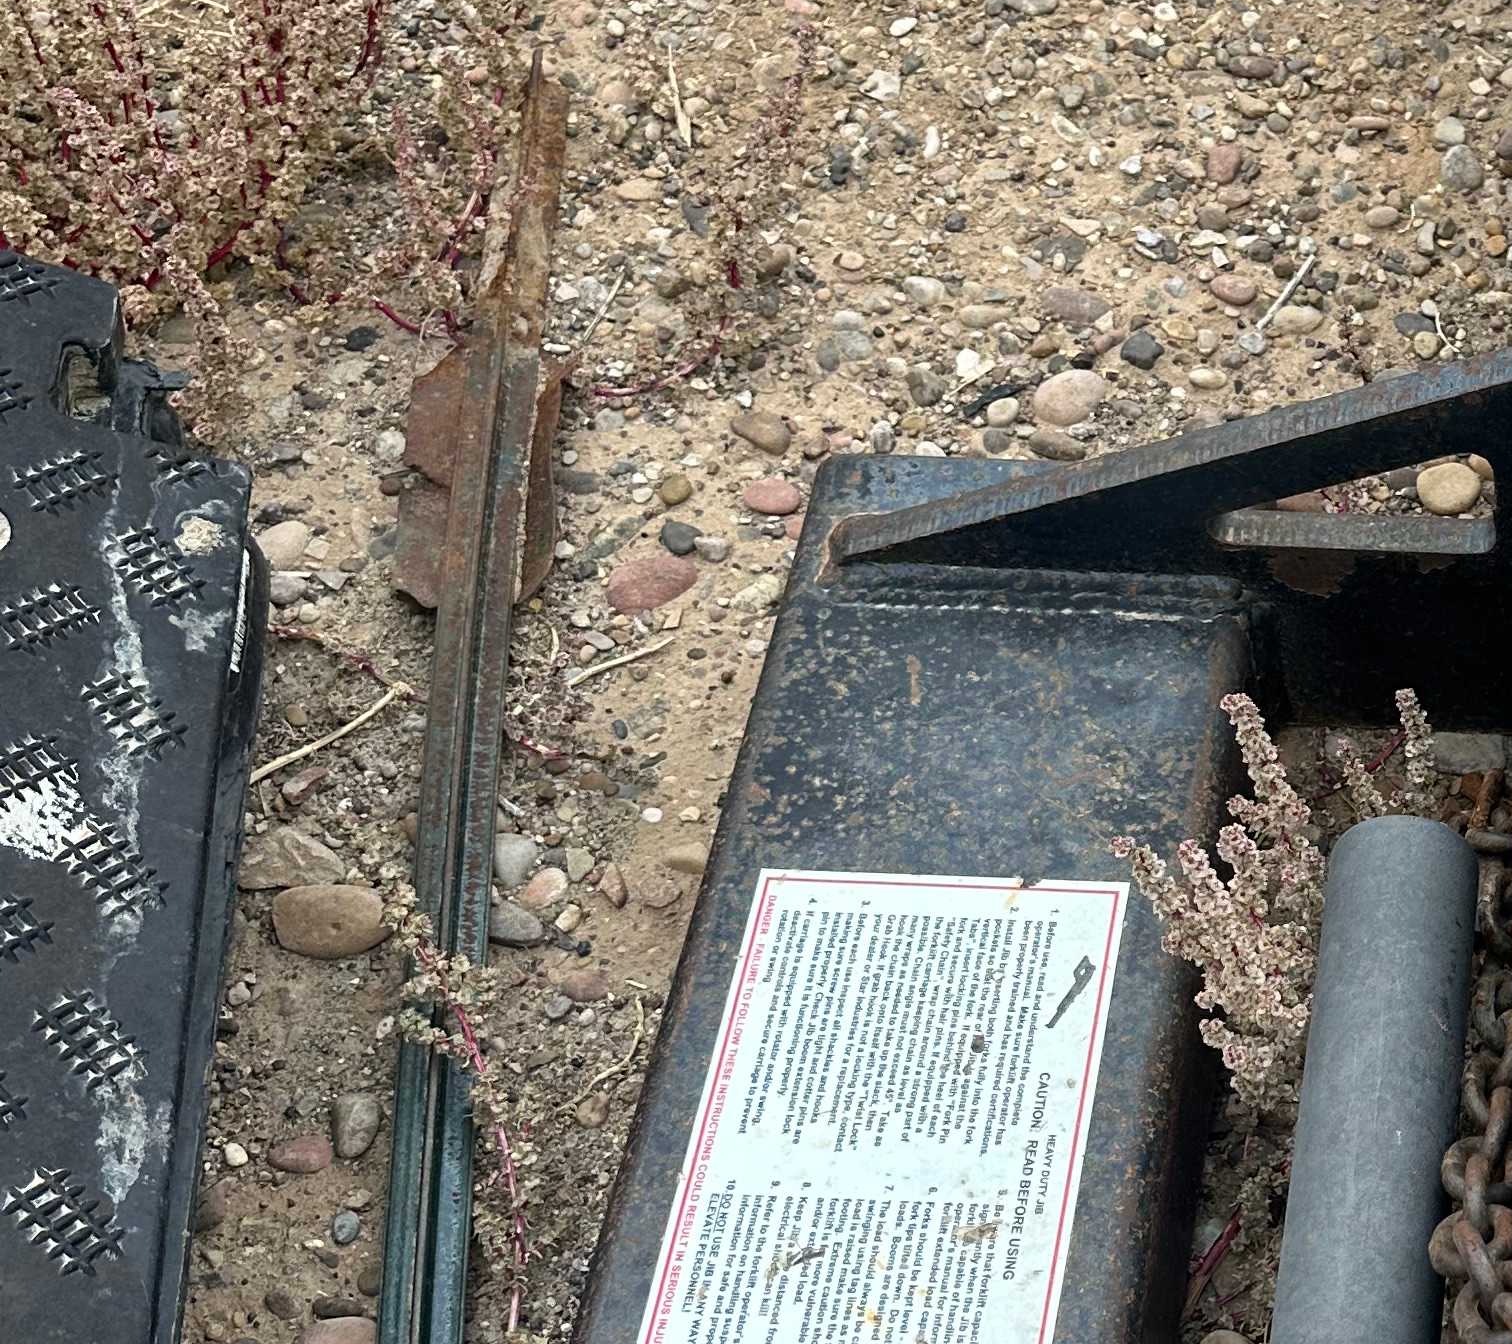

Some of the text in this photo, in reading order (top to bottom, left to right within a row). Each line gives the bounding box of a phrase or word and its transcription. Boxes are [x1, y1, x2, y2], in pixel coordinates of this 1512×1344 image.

[759, 894, 777, 935] DANGER
[746, 943, 765, 984] FAILURE
[741, 987, 754, 1000] TO
[730, 1002, 749, 1045] FOLLOW
[721, 1047, 738, 1081] THESE
[700, 1083, 728, 1161] INSTRUCTIONS
[1021, 1139, 1038, 1176] READ
[1033, 1134, 1056, 1215] HEAVY DUTY JIB
[689, 1163, 708, 1202] COULD
[678, 1204, 697, 1247] RESULT
[713, 1211, 729, 1234] NOT
[1010, 1179, 1031, 1234] BEFORE
[674, 1250, 685, 1261] IN
[680, 1192, 720, 1313] ELEVATE PERSONNEL!
[707, 1235, 723, 1258] USE
[1001, 1237, 1021, 1280] USING
[703, 1259, 716, 1277] JIB
[659, 1264, 681, 1315] SERIOUS
[693, 1292, 708, 1317] ANY
